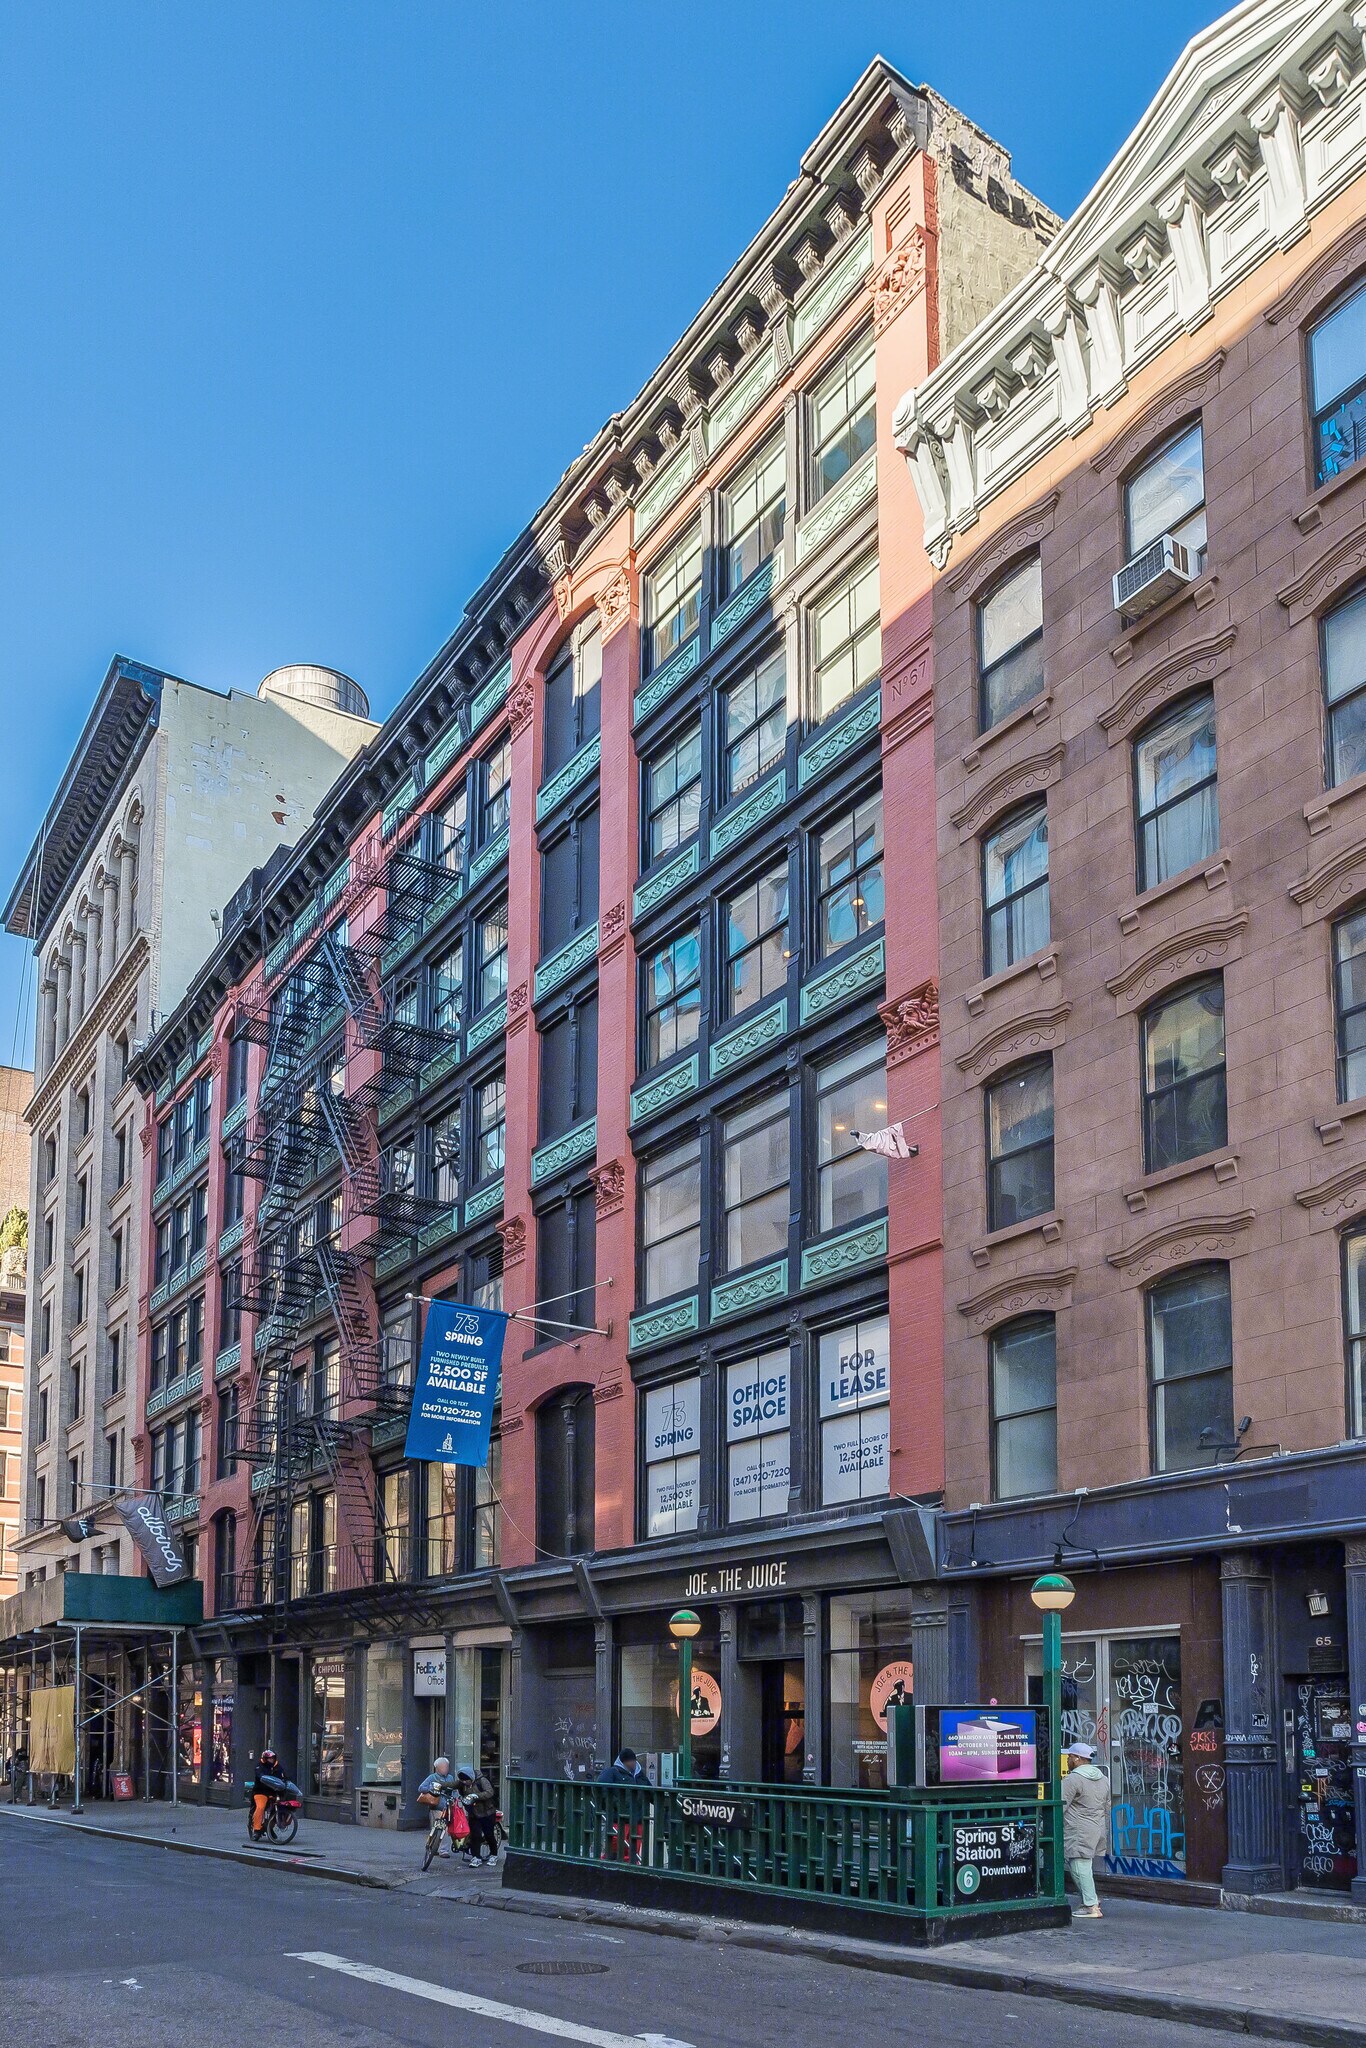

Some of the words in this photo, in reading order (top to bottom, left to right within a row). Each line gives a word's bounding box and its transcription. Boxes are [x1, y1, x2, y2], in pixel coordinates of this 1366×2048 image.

[453, 1312, 480, 1335] 73
[444, 1330, 484, 1347] SPRING
[430, 1356, 460, 1366] FURNISHED
[460, 1361, 489, 1371] PREBUILTS
[436, 1350, 450, 1358] TWO
[450, 1353, 470, 1361] NEWLY
[470, 1356, 485, 1364] BUILT
[840, 1348, 875, 1375] FOR
[429, 1362, 471, 1380] 12,500
[473, 1370, 488, 1382] SF
[426, 1375, 486, 1395] AVAILABLE
[732, 1374, 786, 1405] OFFICE
[830, 1367, 886, 1402] LEASE
[422, 1402, 441, 1413] (347)
[442, 1406, 482, 1419] 920-7220
[662, 1401, 686, 1432] 73
[732, 1396, 786, 1428] SPACE
[445, 1416, 481, 1426] INFORMATION
[655, 1427, 694, 1448] SPRING
[833, 1442, 846, 1451] TWO
[846, 1440, 858, 1448] FULL
[880, 1432, 889, 1440] OF
[839, 1447, 870, 1462] 12,500
[872, 1444, 883, 1455] SF
[838, 1456, 884, 1475] AVAILABLE
[733, 1474, 751, 1487] (347)
[752, 1466, 790, 1482] 920-7220
[660, 1491, 684, 1503] 12,500
[685, 1489, 693, 1498] SF
[137, 1506, 183, 1573] allbirds
[685, 1572, 708, 1597] JOE
[710, 1586, 718, 1594] &
[718, 1568, 743, 1593] THE
[747, 1561, 788, 1590] JUICE
[1315, 1636, 1332, 1646] 65
[318, 1663, 345, 1674] CHIPOTLE
[416, 1661, 437, 1675] FedEx
[427, 1675, 445, 1686] Office
[692, 1675, 703, 1683] THE
[703, 1679, 718, 1697] JUICE
[874, 1676, 888, 1693] JOE
[885, 1670, 893, 1679] &
[893, 1666, 908, 1675] THE
[1189, 1742, 1218, 1752] WORLD
[1190, 1731, 1215, 1744] SICK!
[682, 1798, 735, 1823] Subway
[955, 1829, 997, 1846] Spring
[1001, 1827, 1016, 1841] St
[955, 1845, 1001, 1861] Station
[963, 1871, 974, 1888] 6
[981, 1865, 1026, 1876] Downtown
